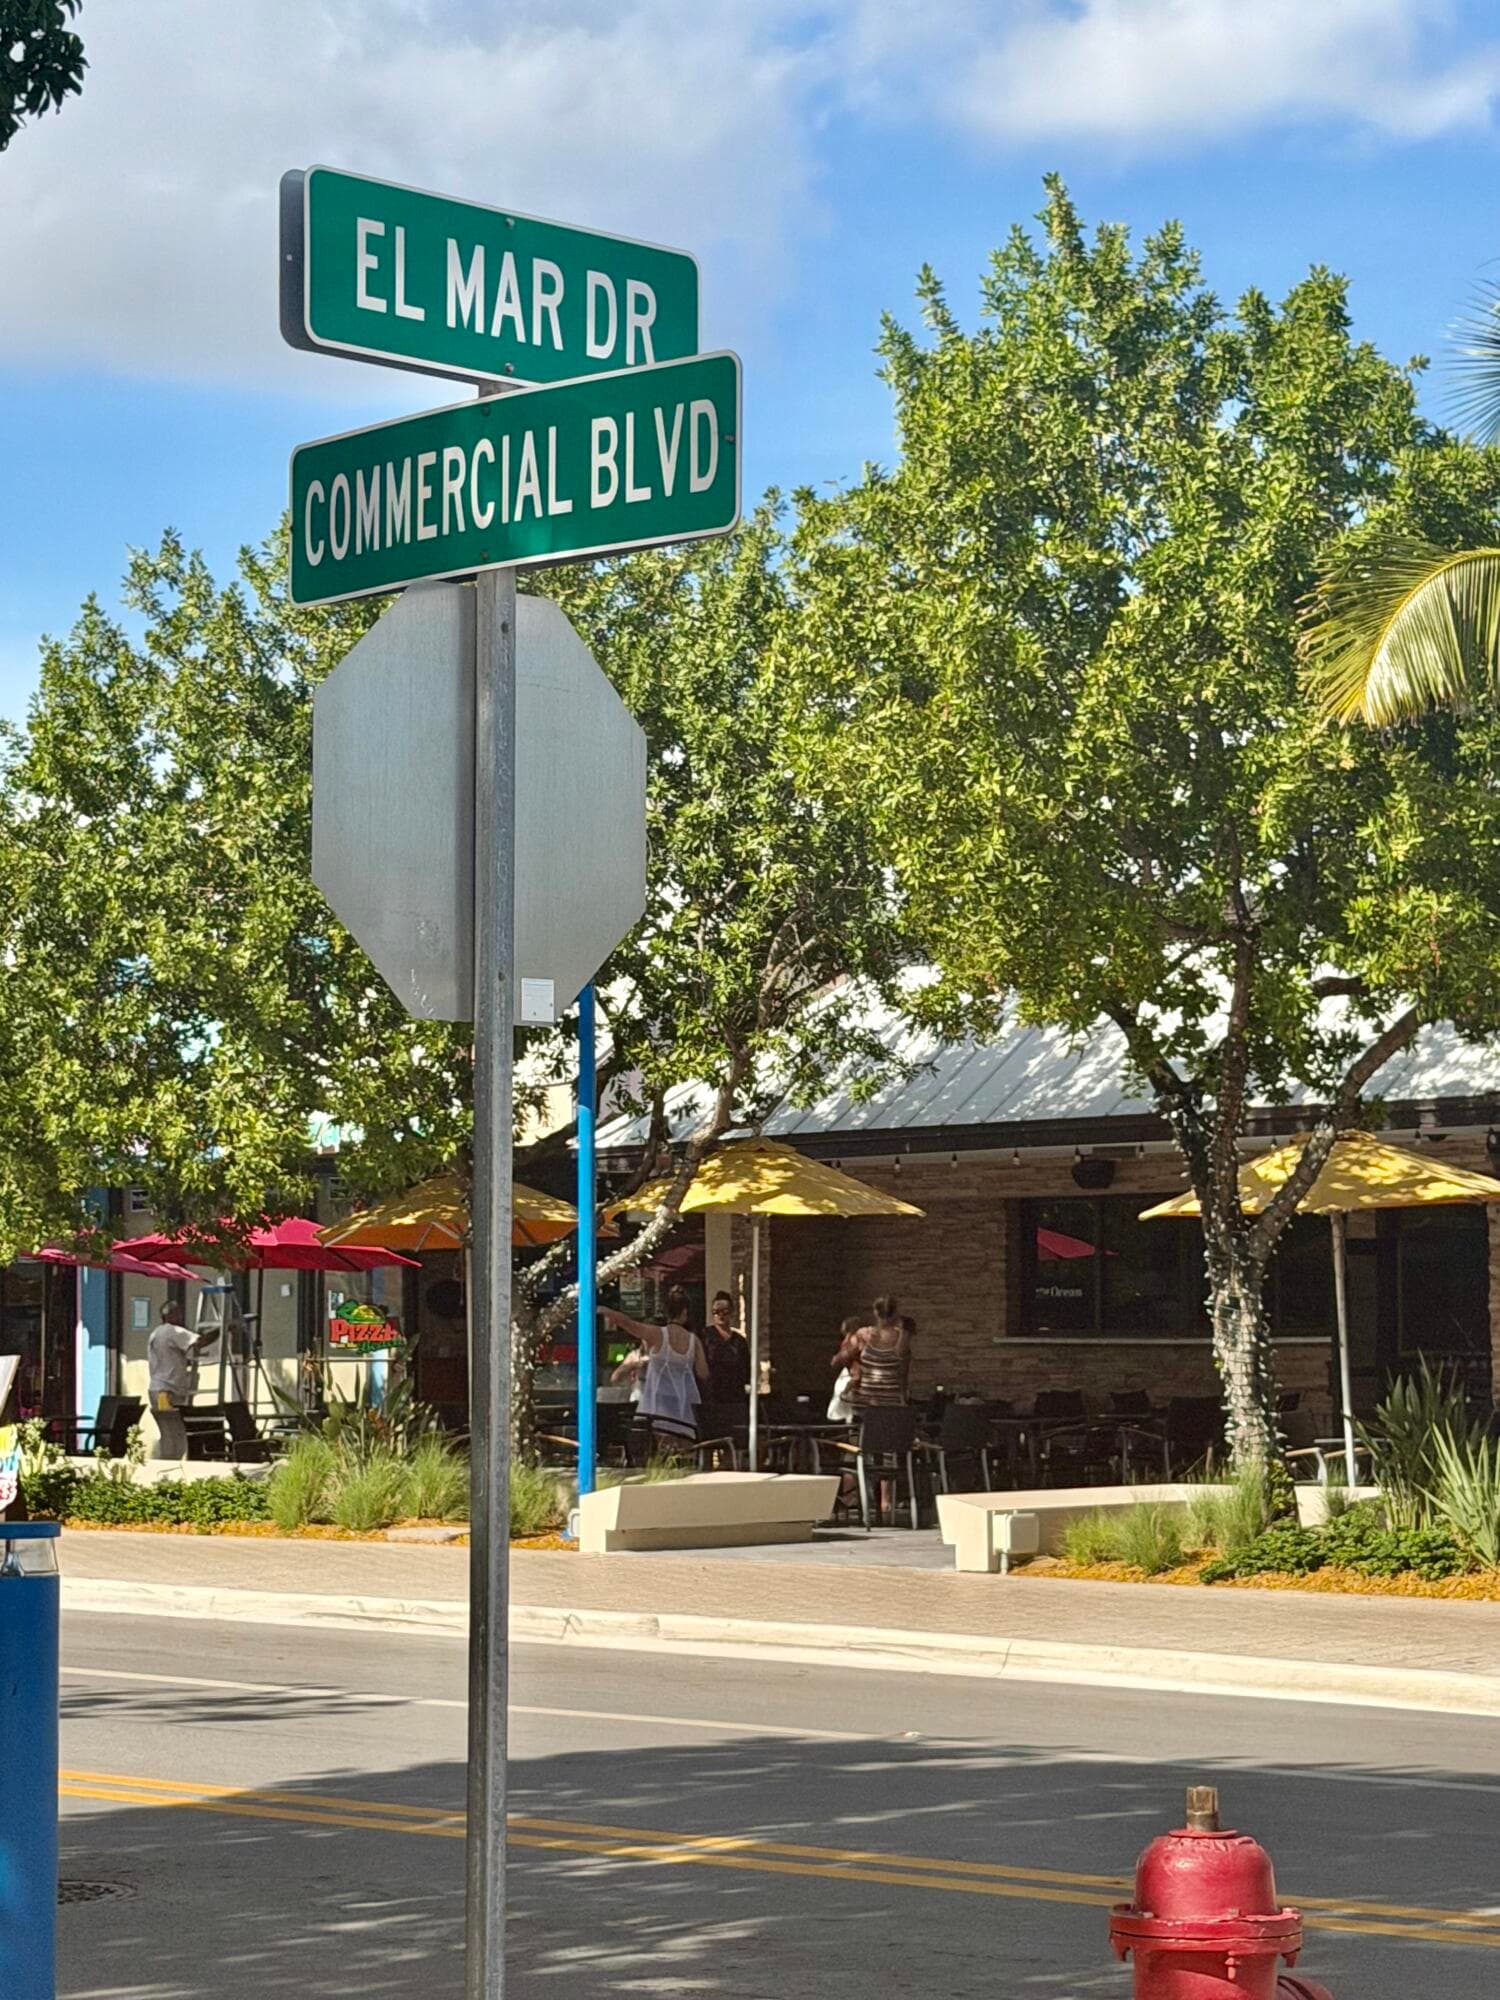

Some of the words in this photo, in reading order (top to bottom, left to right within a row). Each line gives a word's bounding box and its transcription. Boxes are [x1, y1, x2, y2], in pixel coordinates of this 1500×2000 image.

[356, 217, 425, 322] EL
[446, 238, 565, 352] MAR
[586, 269, 659, 366] DR
[304, 425, 574, 567] COMMERCIAL
[590, 398, 719, 510] BLVD
